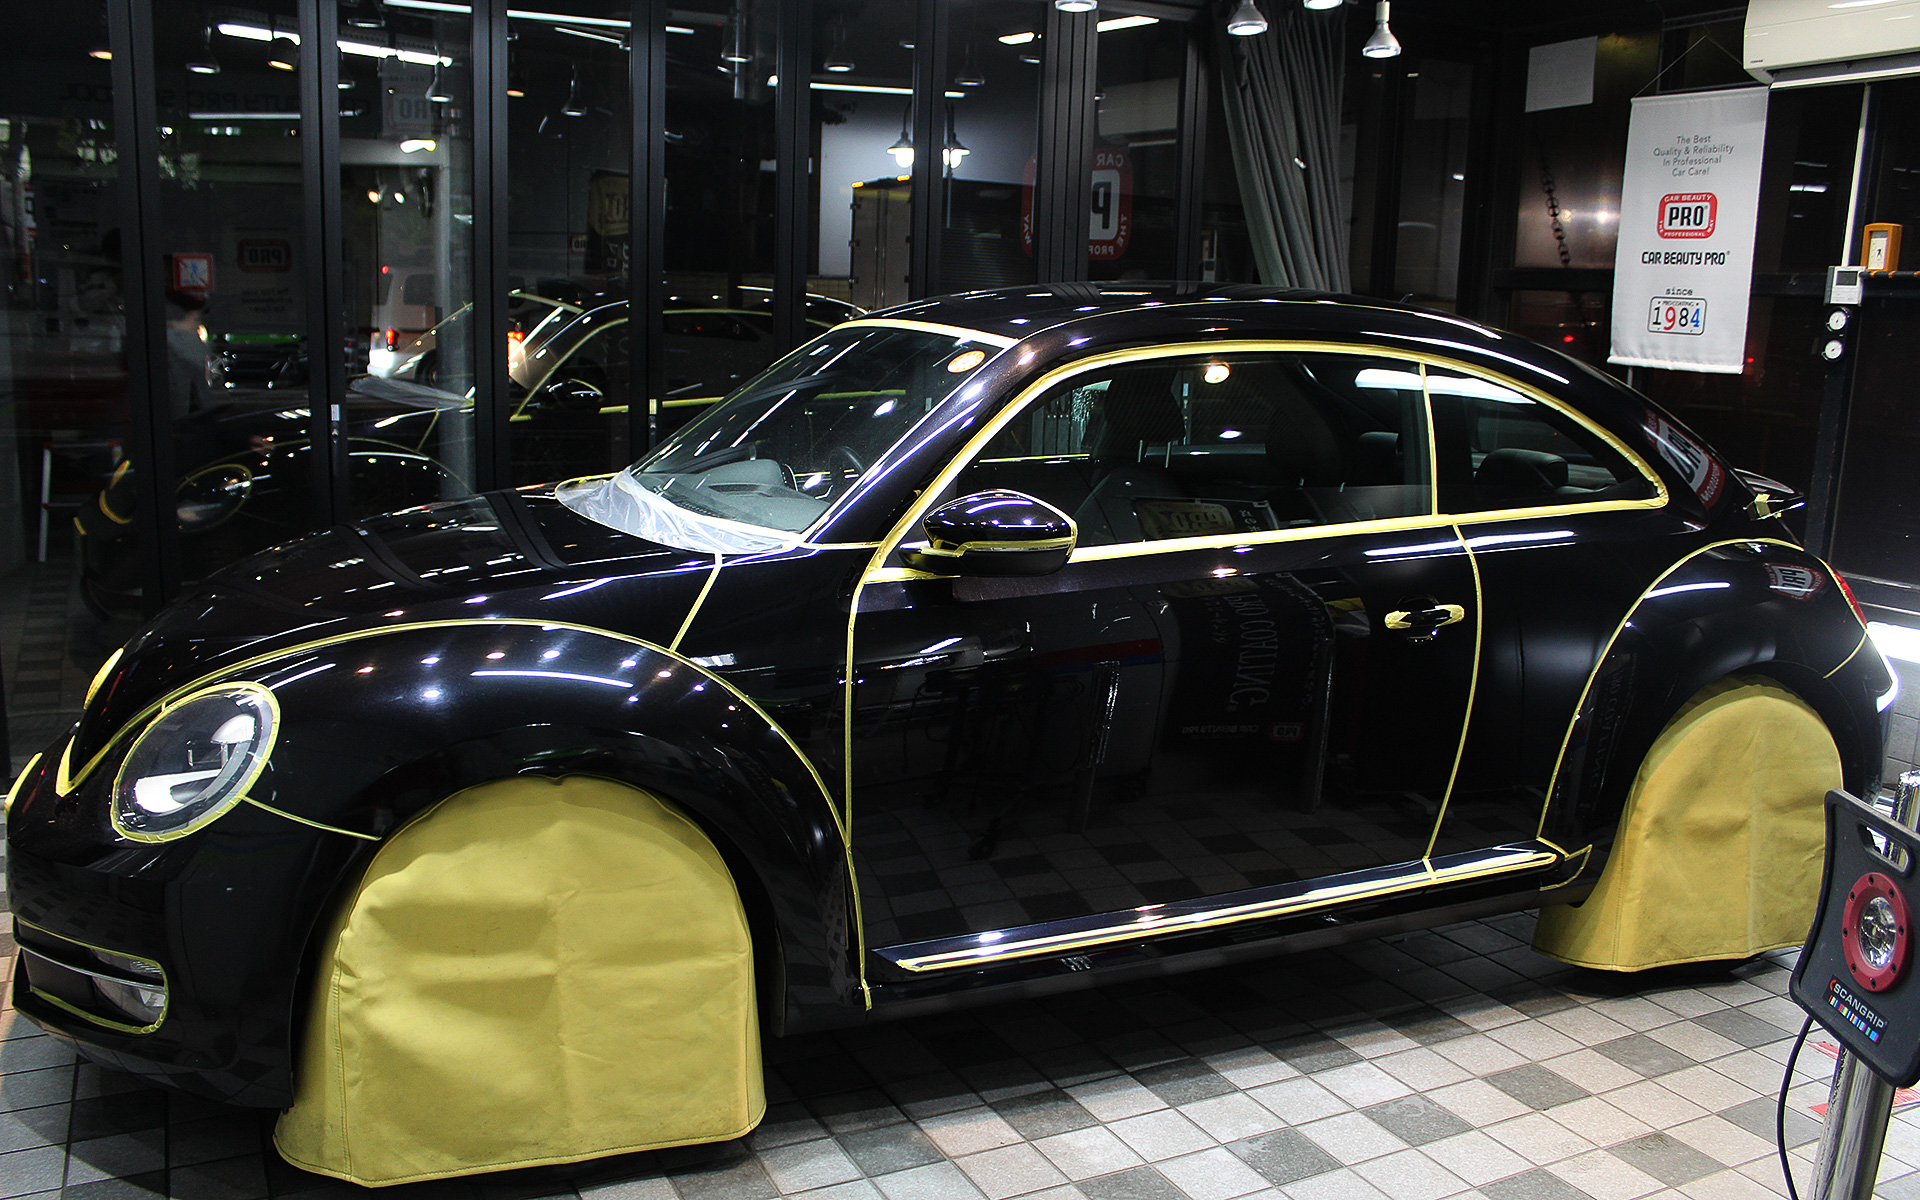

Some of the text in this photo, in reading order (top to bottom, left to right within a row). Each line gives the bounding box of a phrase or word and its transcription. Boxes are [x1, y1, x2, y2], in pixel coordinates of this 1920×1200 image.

[1675, 134, 1711, 145] The Best
[1653, 144, 1735, 158] Quality & Reliability
[1662, 155, 1722, 167] In Professional
[1672, 167, 1710, 177] Car Care!
[1664, 195, 1680, 203] CAR
[1667, 205, 1704, 226] PRO
[1641, 251, 1726, 265] CAR BEAUTY PRO
[1665, 286, 1693, 296] since
[1652, 306, 1700, 331] 1984
[1833, 983, 1884, 1029] SCANGRIP
